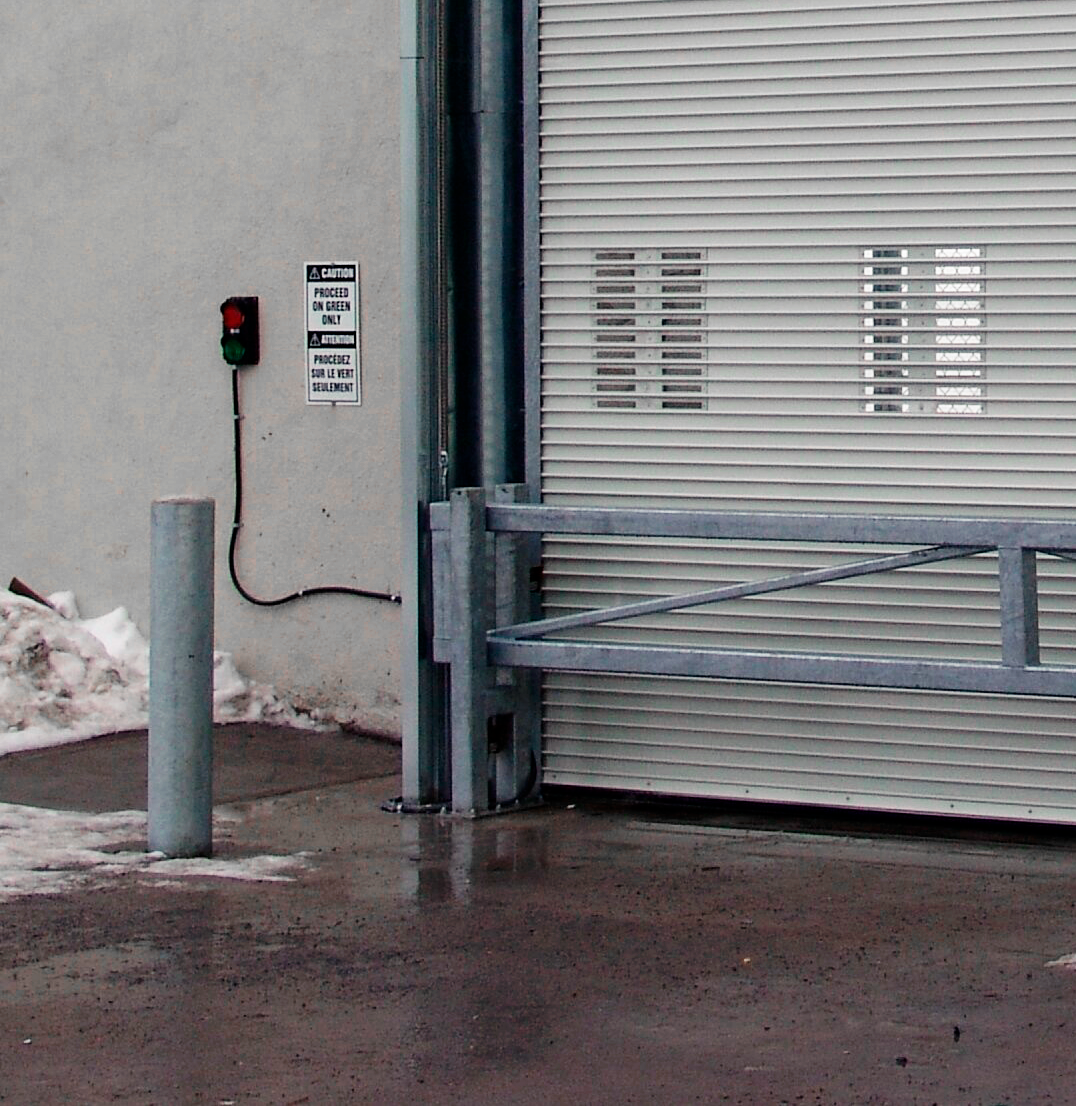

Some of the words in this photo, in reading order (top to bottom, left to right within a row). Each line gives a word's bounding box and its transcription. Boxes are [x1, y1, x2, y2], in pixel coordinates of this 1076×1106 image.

[321, 268, 354, 279] CAUTION
[314, 287, 349, 298] PROCEED
[312, 301, 323, 312] ON
[326, 301, 351, 312] GREEN
[322, 314, 341, 325] ONLY
[311, 368, 325, 379] SUR
[327, 368, 335, 379] LE
[337, 368, 354, 379] VERT
[312, 382, 354, 393] SEULEMENT
